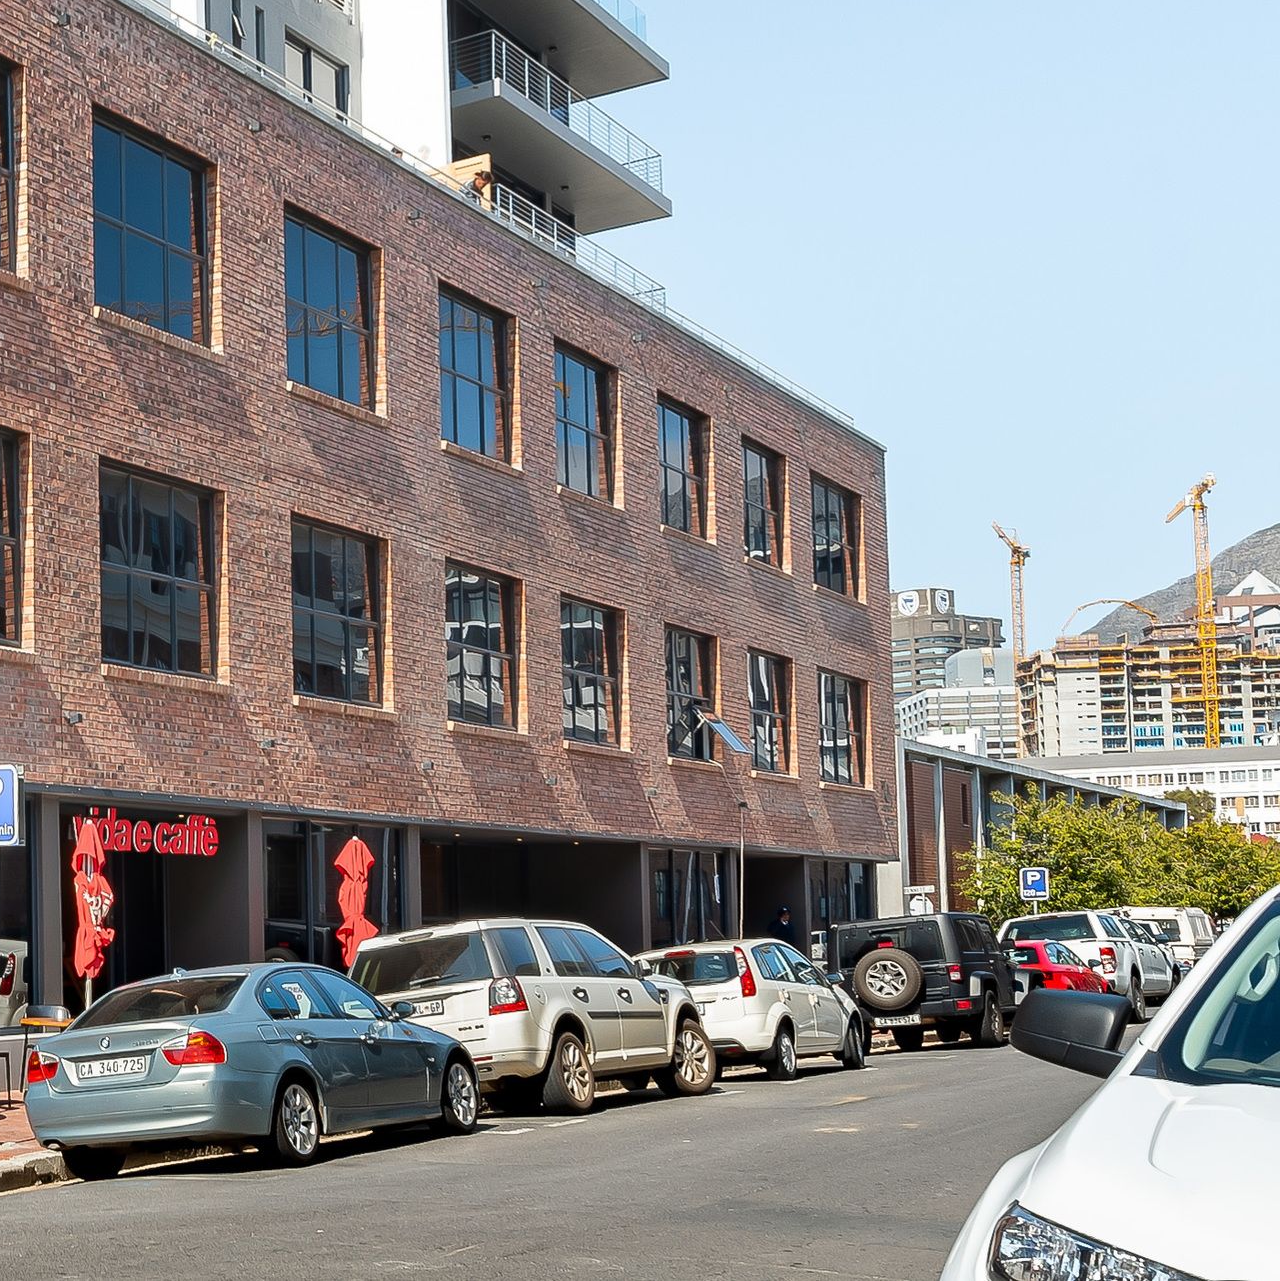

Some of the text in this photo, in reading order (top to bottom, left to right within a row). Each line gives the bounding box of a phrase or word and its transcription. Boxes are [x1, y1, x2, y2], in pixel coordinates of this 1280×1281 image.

[133, 820, 153, 853] e
[1027, 871, 1041, 886] P
[430, 1002, 441, 1013] GP
[80, 1064, 93, 1076] CA
